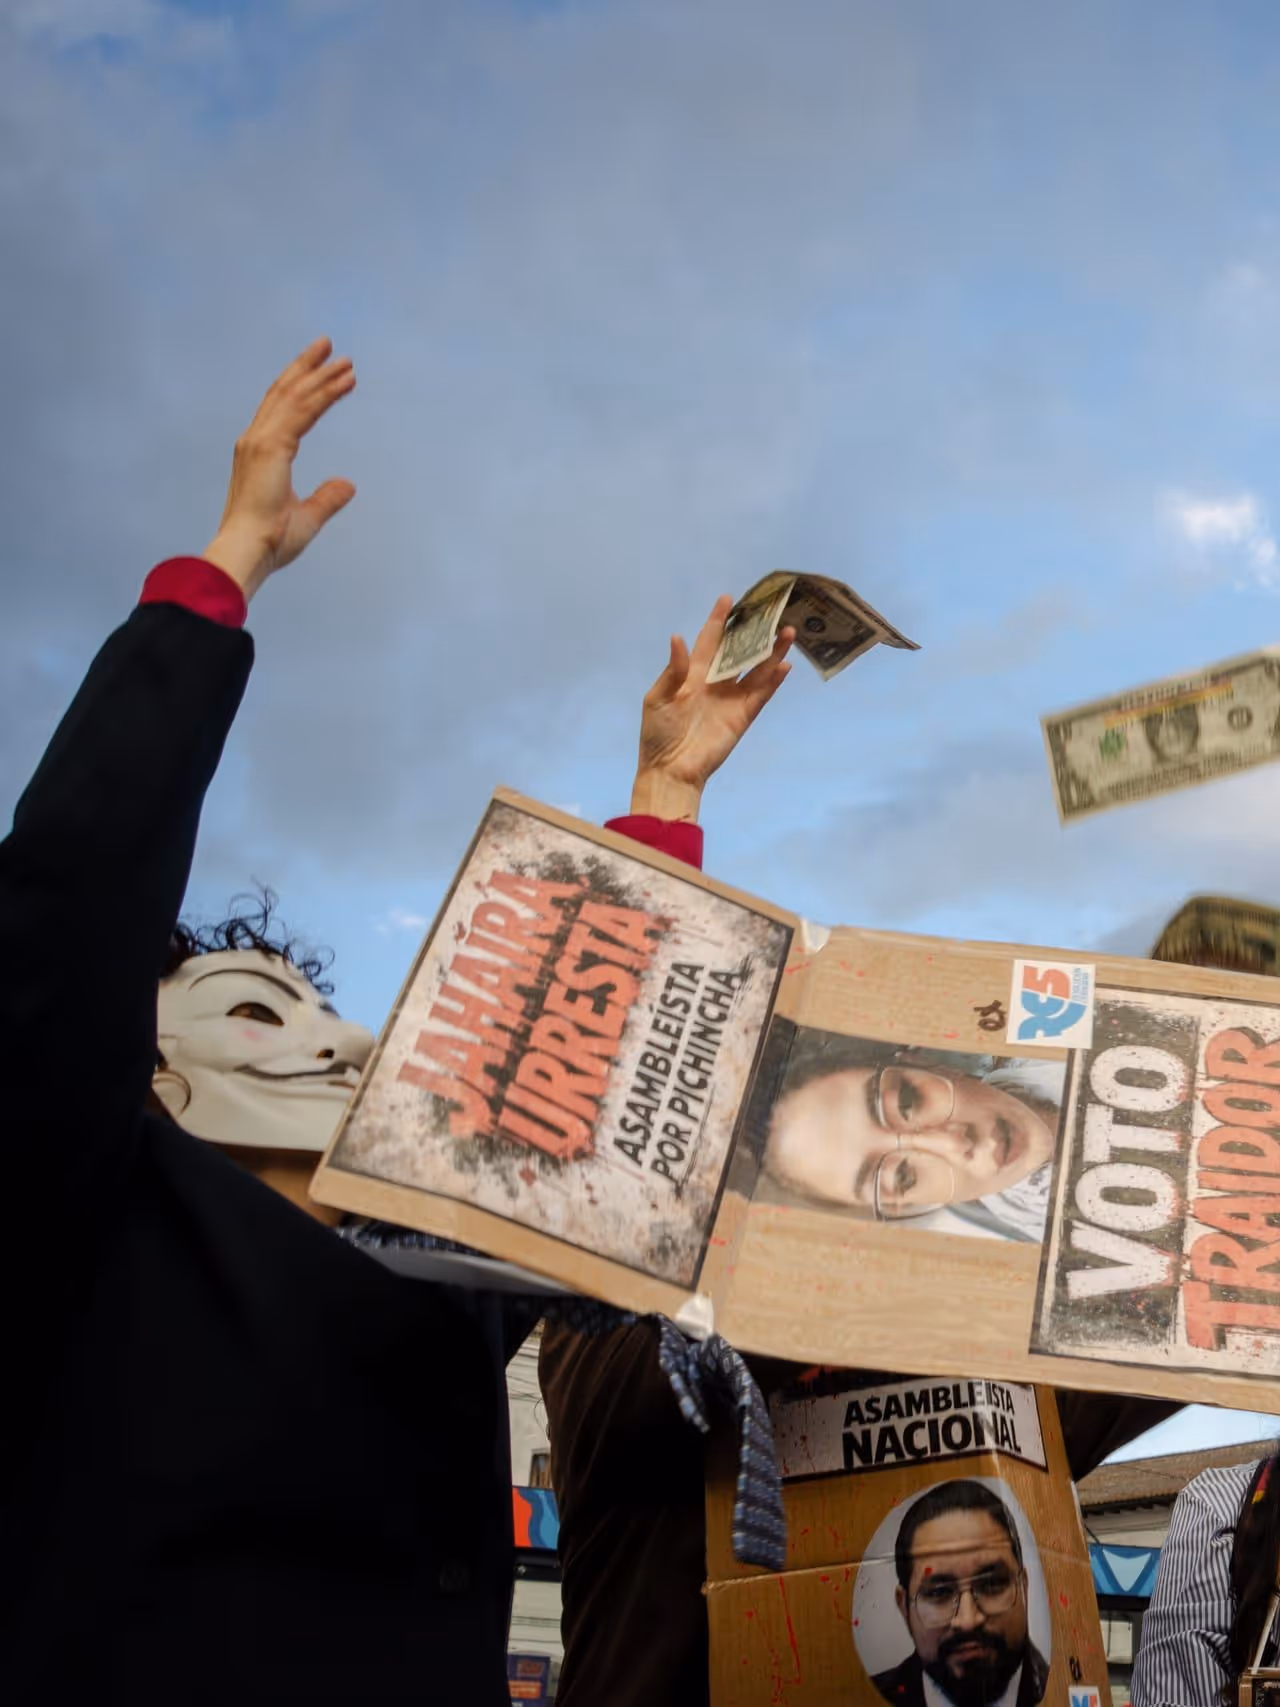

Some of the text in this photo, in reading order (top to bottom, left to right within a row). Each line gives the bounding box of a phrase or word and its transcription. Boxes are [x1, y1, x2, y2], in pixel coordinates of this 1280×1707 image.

[498, 901, 660, 1158] URRESTA
[613, 963, 704, 1166] ASAMBLEÍSTA
[651, 970, 738, 1186] POR PICHINCHA
[1066, 1045, 1188, 1300] VOTO
[842, 1411, 1022, 1470] NACIONAL
